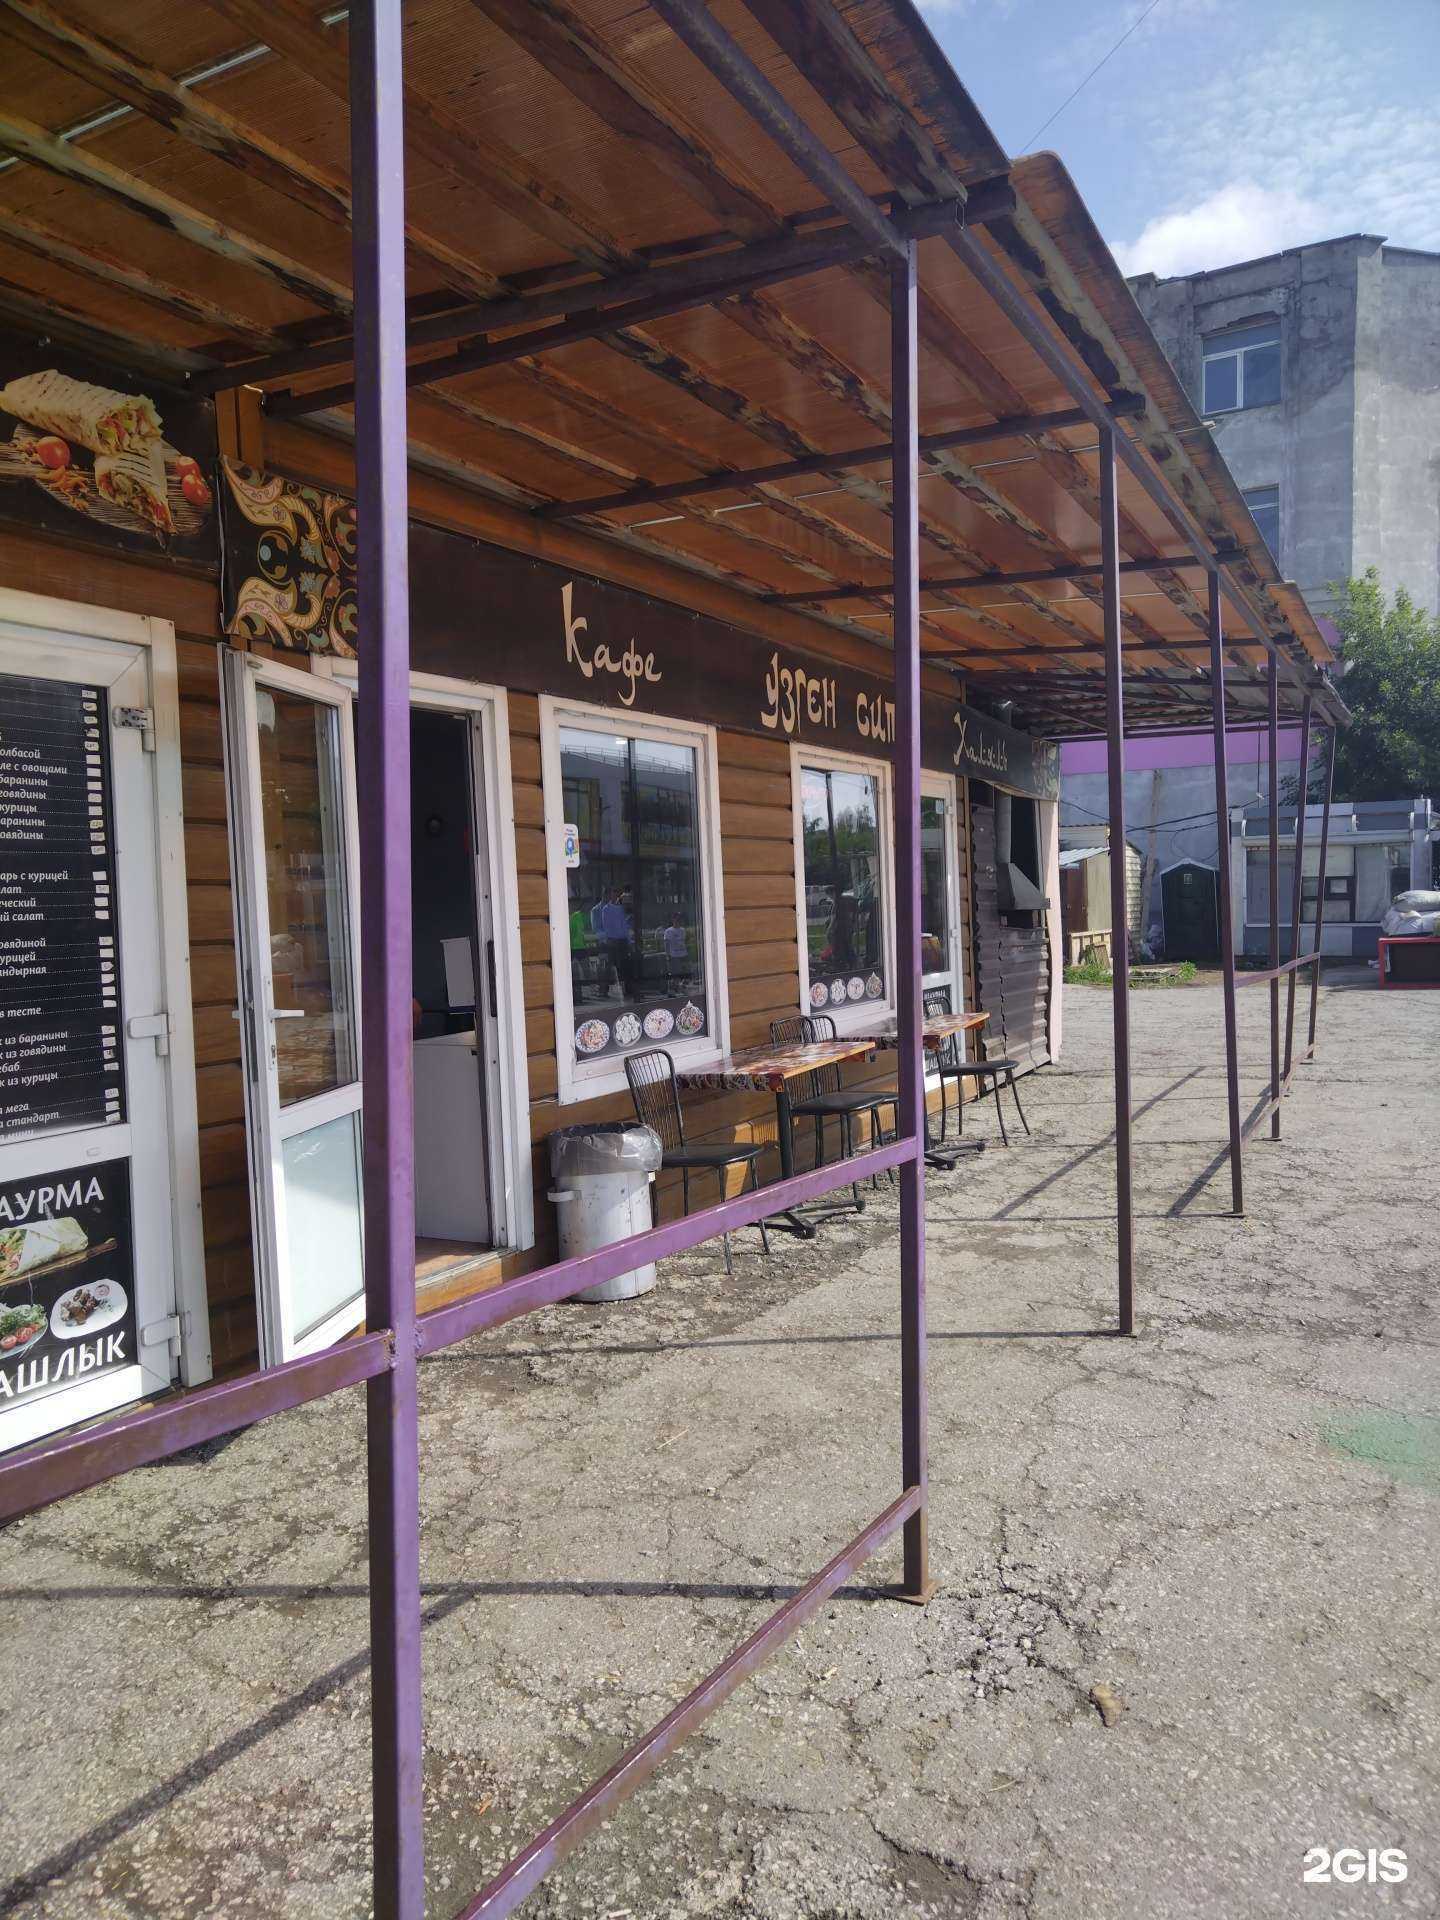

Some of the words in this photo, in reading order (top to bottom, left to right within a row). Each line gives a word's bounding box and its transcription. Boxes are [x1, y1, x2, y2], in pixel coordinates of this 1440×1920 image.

[560, 581, 662, 705] Кафе
[14, 763, 20, 771] с
[22, 764, 68, 775] овощами
[0, 774, 48, 787] баранины
[0, 803, 38, 814] курицы
[0, 817, 46, 828] аранины
[28, 870, 69, 883] курицей
[12, 913, 44, 921] салат
[7, 1006, 42, 1018] тесте
[5, 1036, 16, 1045] из
[19, 1030, 68, 1046] баранины
[5, 1050, 17, 1059] из
[20, 1044, 66, 1057] говядины
[7, 1077, 19, 1086] из
[21, 1071, 58, 1087] курицы
[5, 1103, 29, 1114] мега
[6, 1111, 60, 1127] стандарт
[0, 1177, 104, 1221] АУРМА
[0, 1331, 125, 1398] АШЛЫК
